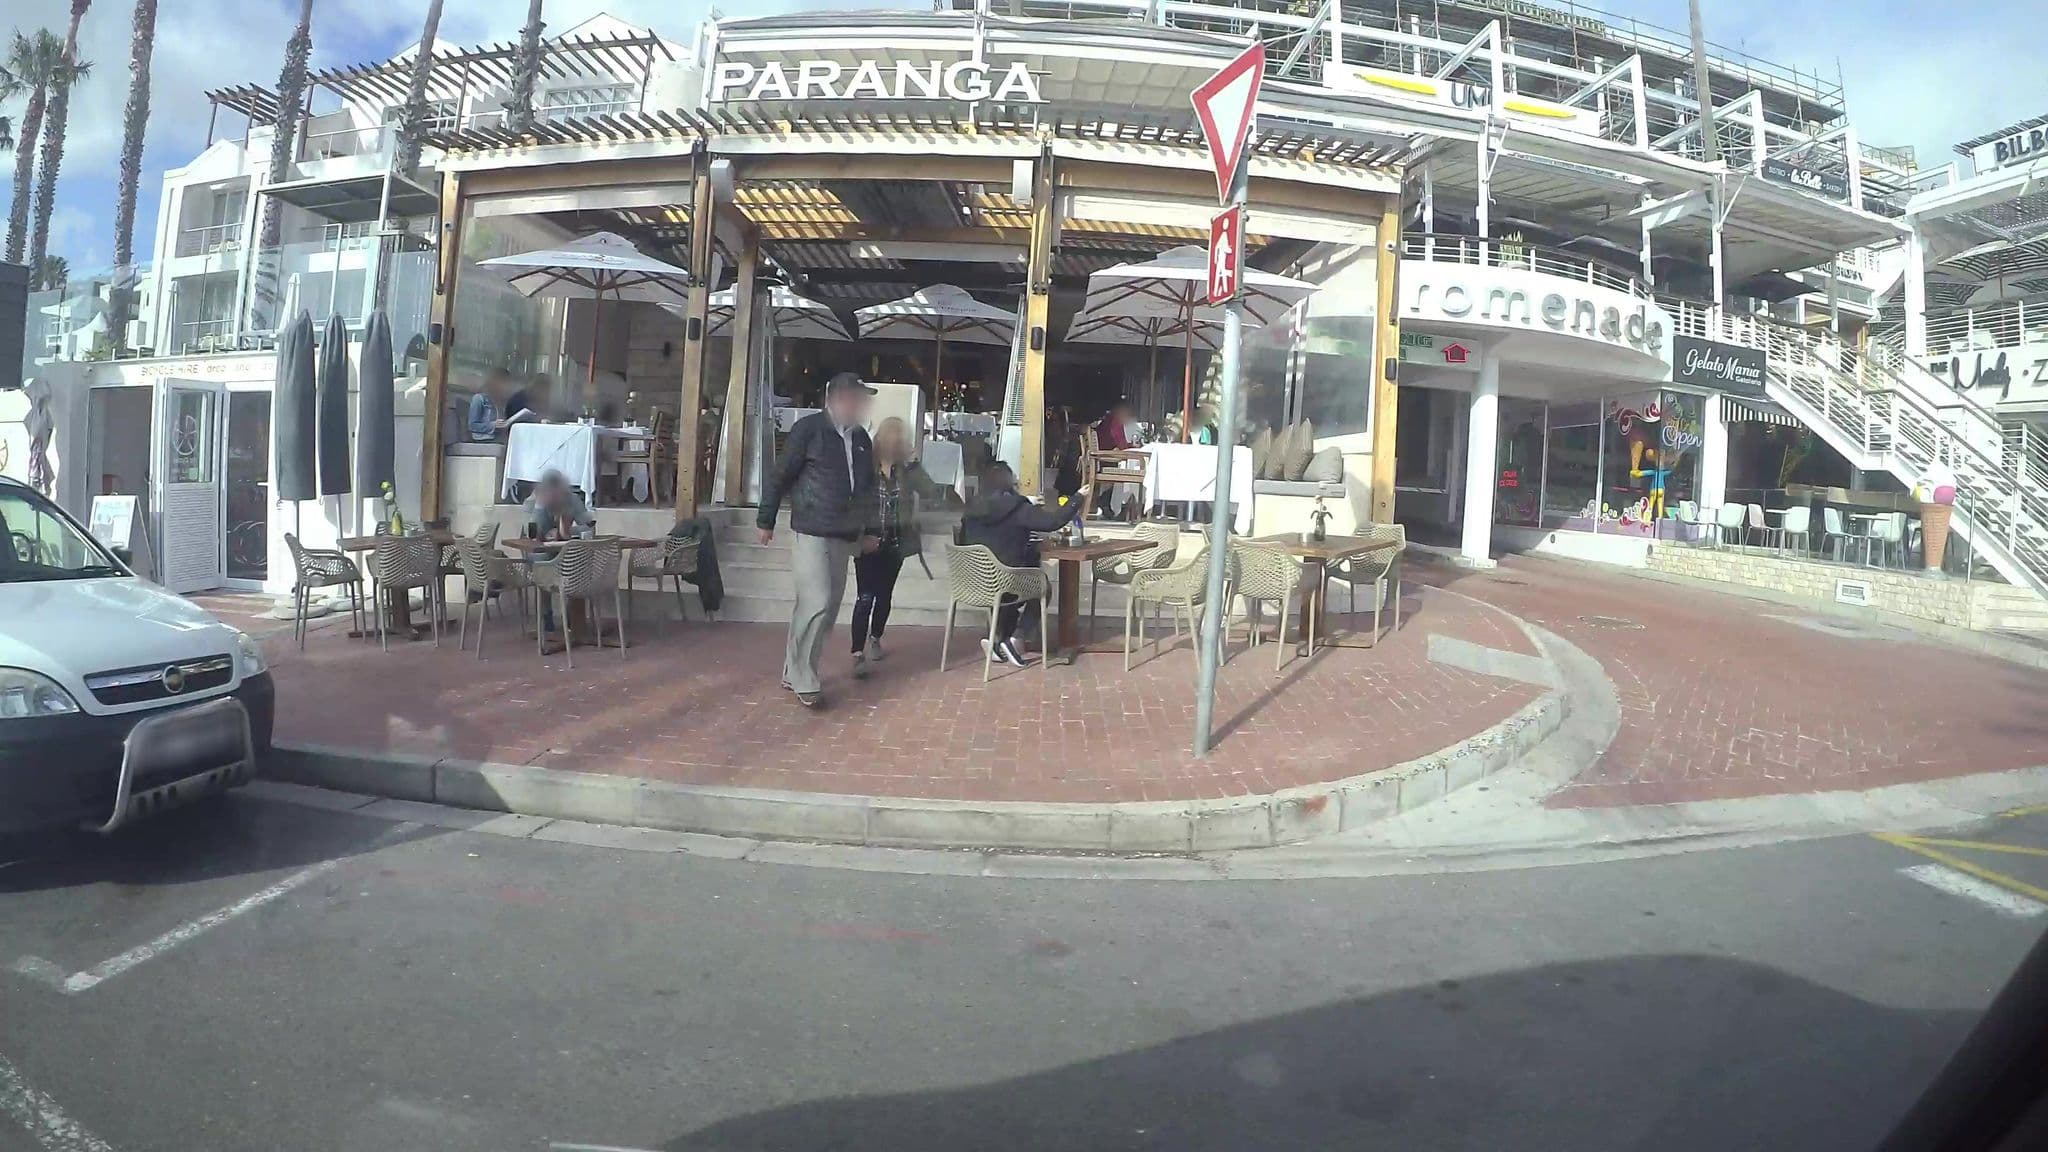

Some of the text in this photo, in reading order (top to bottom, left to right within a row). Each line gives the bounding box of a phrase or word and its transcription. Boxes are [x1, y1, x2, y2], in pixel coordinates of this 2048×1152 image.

[712, 59, 1042, 101] PARANGA
[1994, 127, 2048, 162] BILB
[1682, 347, 1762, 381] Gelato Mania
